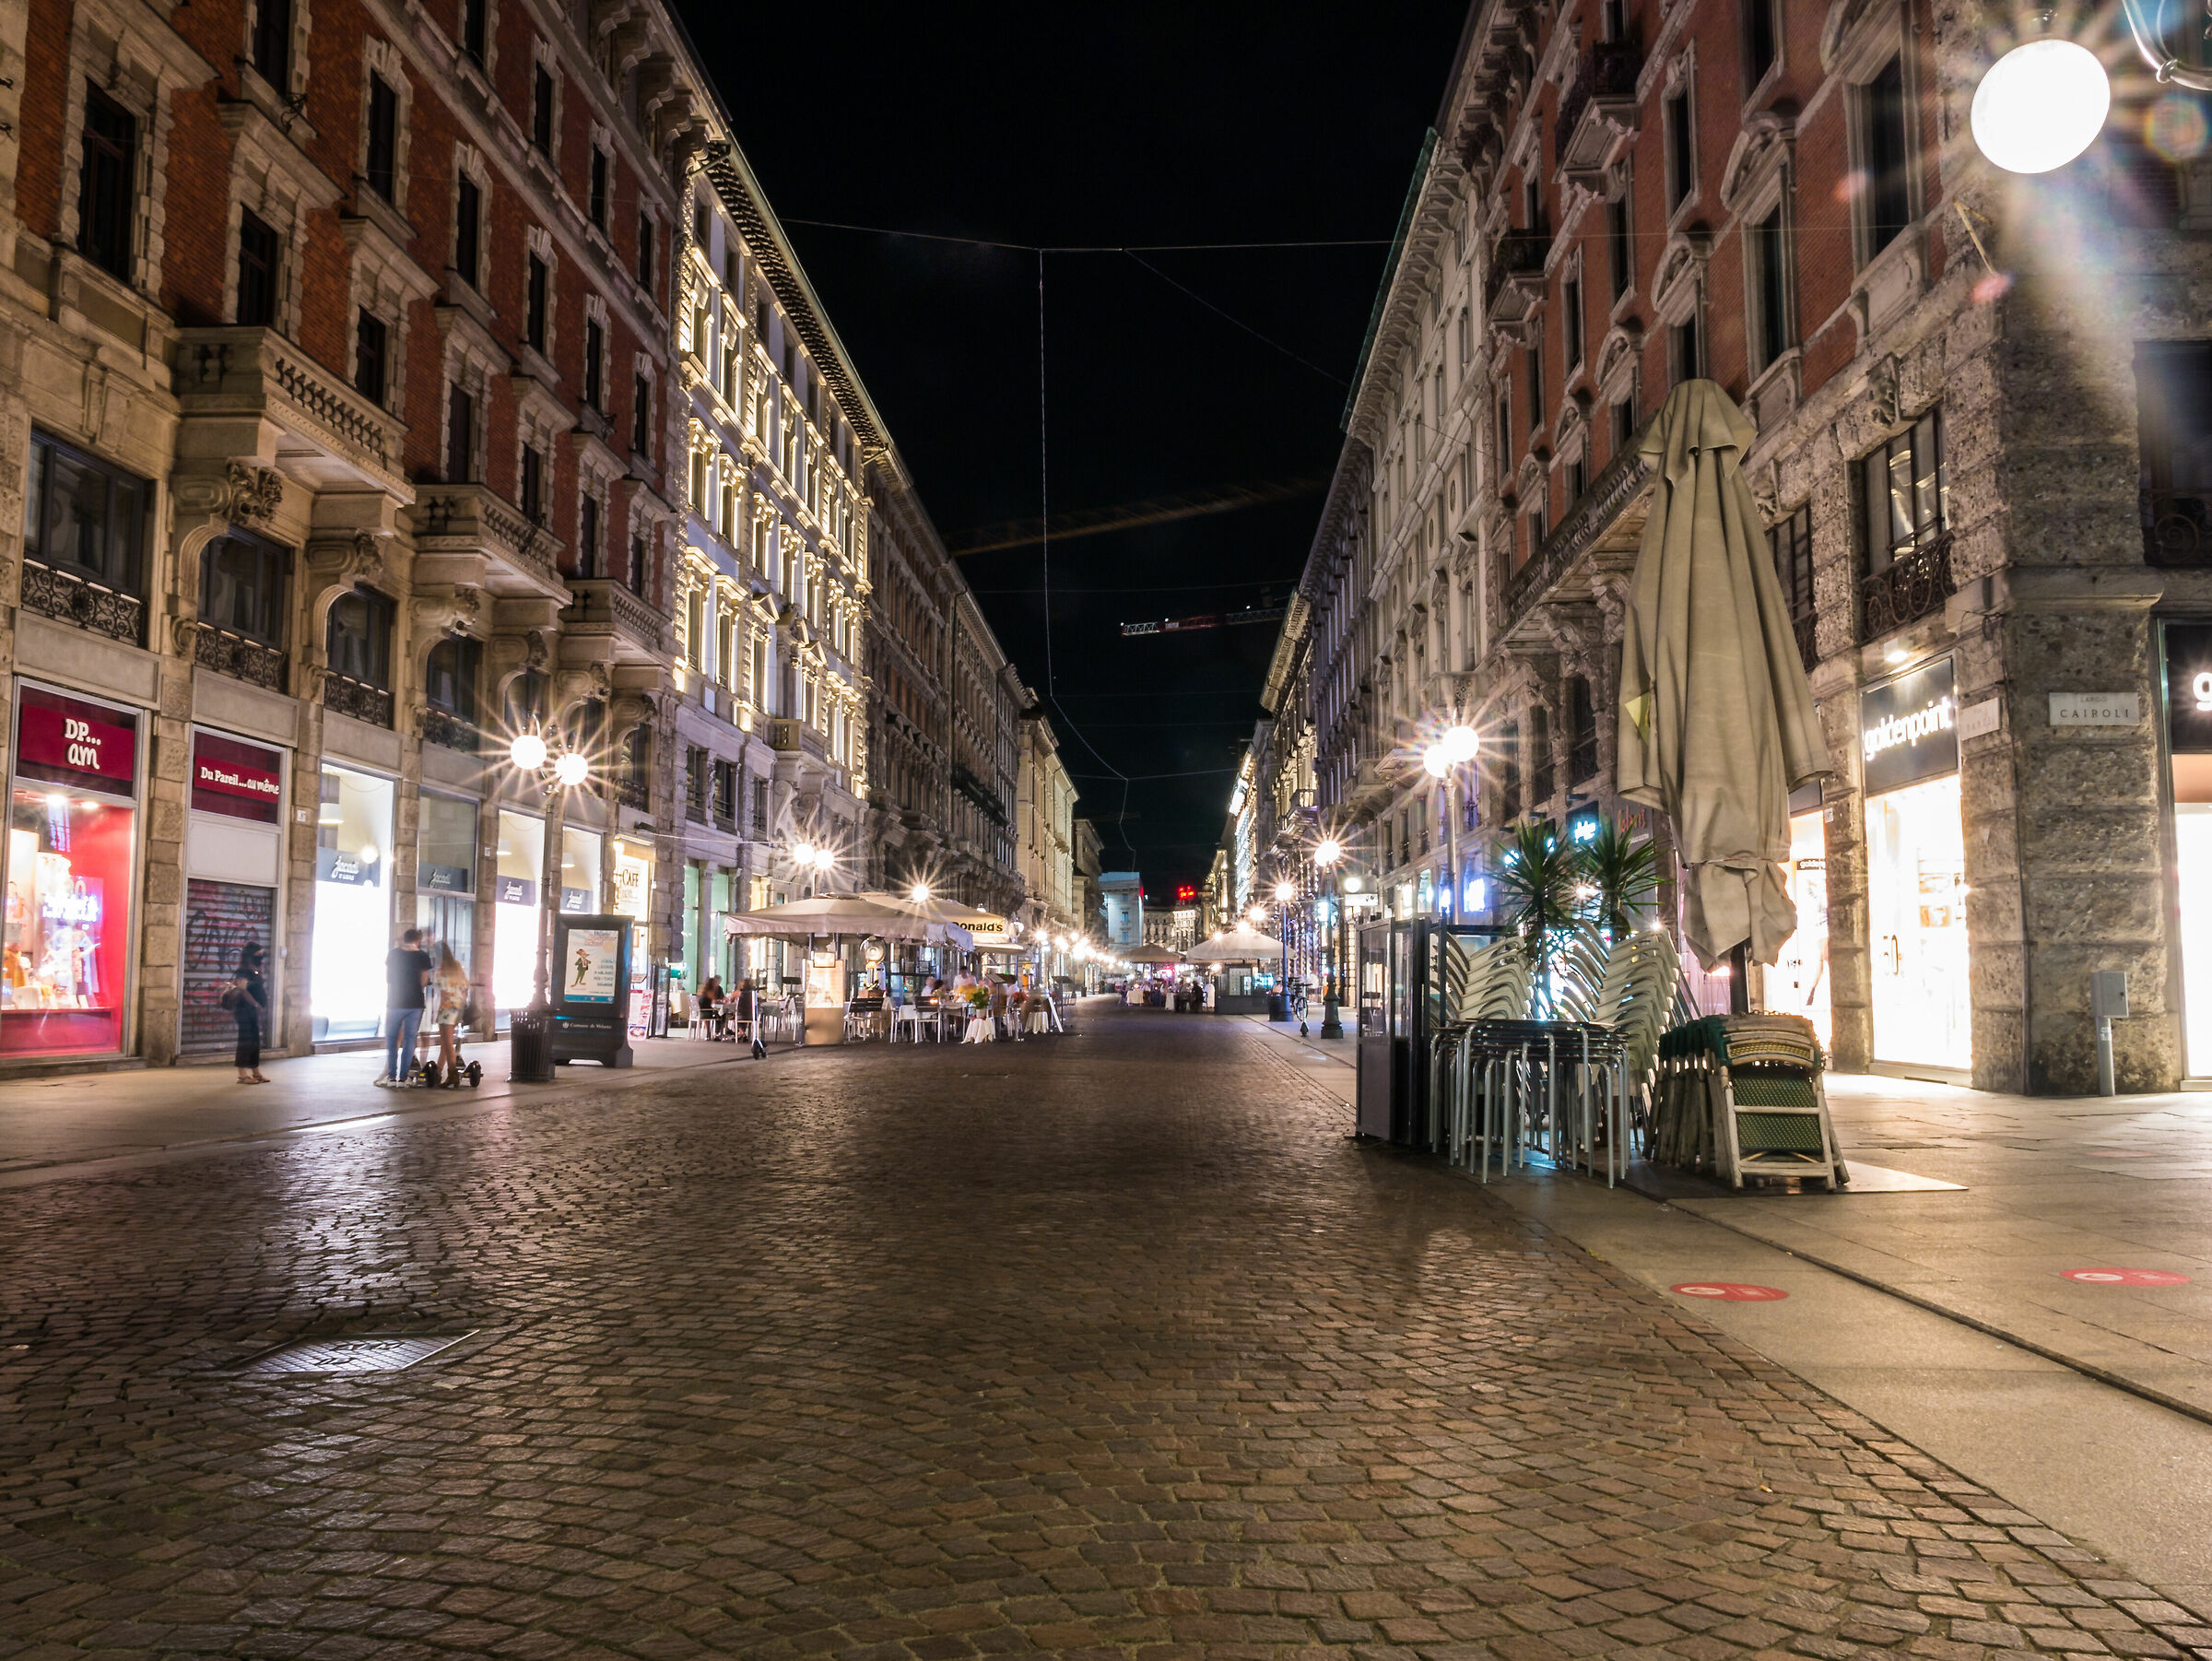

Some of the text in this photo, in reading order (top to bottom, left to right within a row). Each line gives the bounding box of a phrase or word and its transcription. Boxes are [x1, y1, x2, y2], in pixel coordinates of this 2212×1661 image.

[2060, 709, 2128, 718] CAIROLI
[1865, 696, 1953, 761] goldenpoint
[67, 743, 100, 770] am
[200, 766, 214, 781] Du
[257, 778, 279, 795] même
